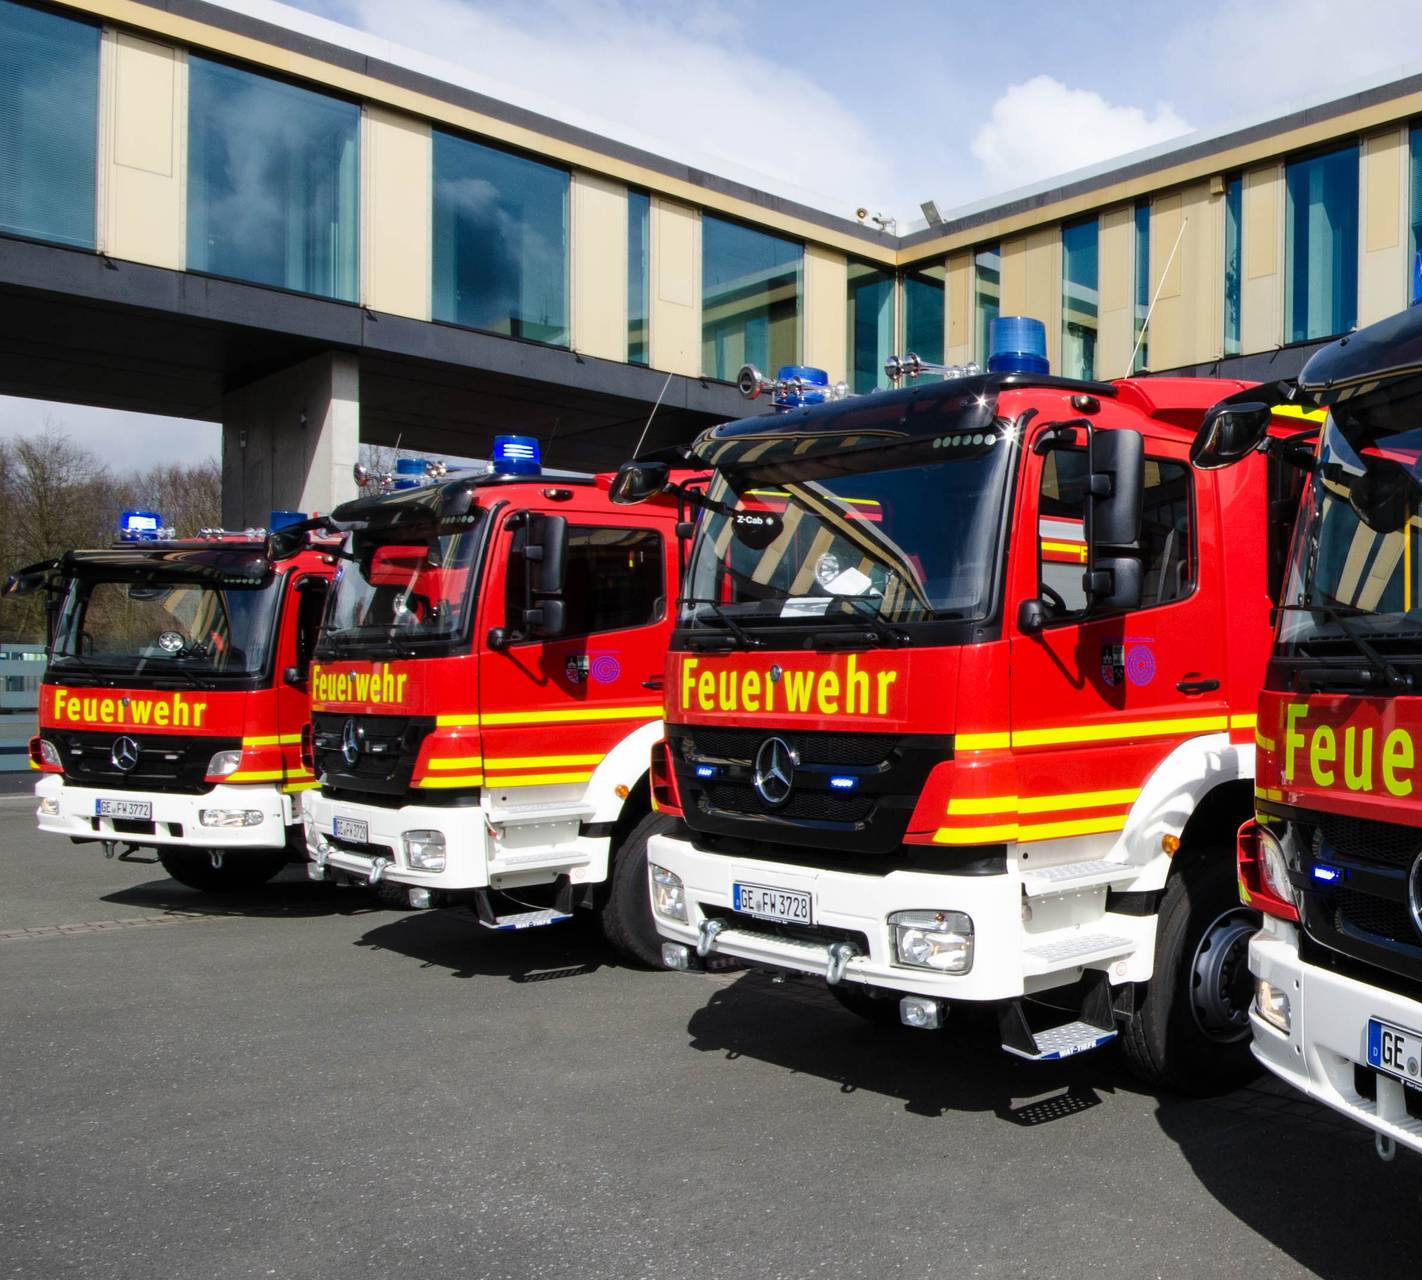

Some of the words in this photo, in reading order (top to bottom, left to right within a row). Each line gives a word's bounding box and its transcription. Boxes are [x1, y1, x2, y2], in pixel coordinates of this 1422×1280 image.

[736, 515, 763, 525] Z-Cab
[312, 662, 408, 704] Feuerwehr
[682, 653, 897, 715] Feuerwehr
[54, 689, 207, 727] Feuerwehr
[101, 801, 111, 813] GE
[117, 802, 127, 815] FW
[129, 803, 149, 816] 3772
[741, 889, 754, 910] GE
[762, 892, 776, 914] FW
[779, 894, 808, 919] 3728
[1382, 1031, 1405, 1071] GE
